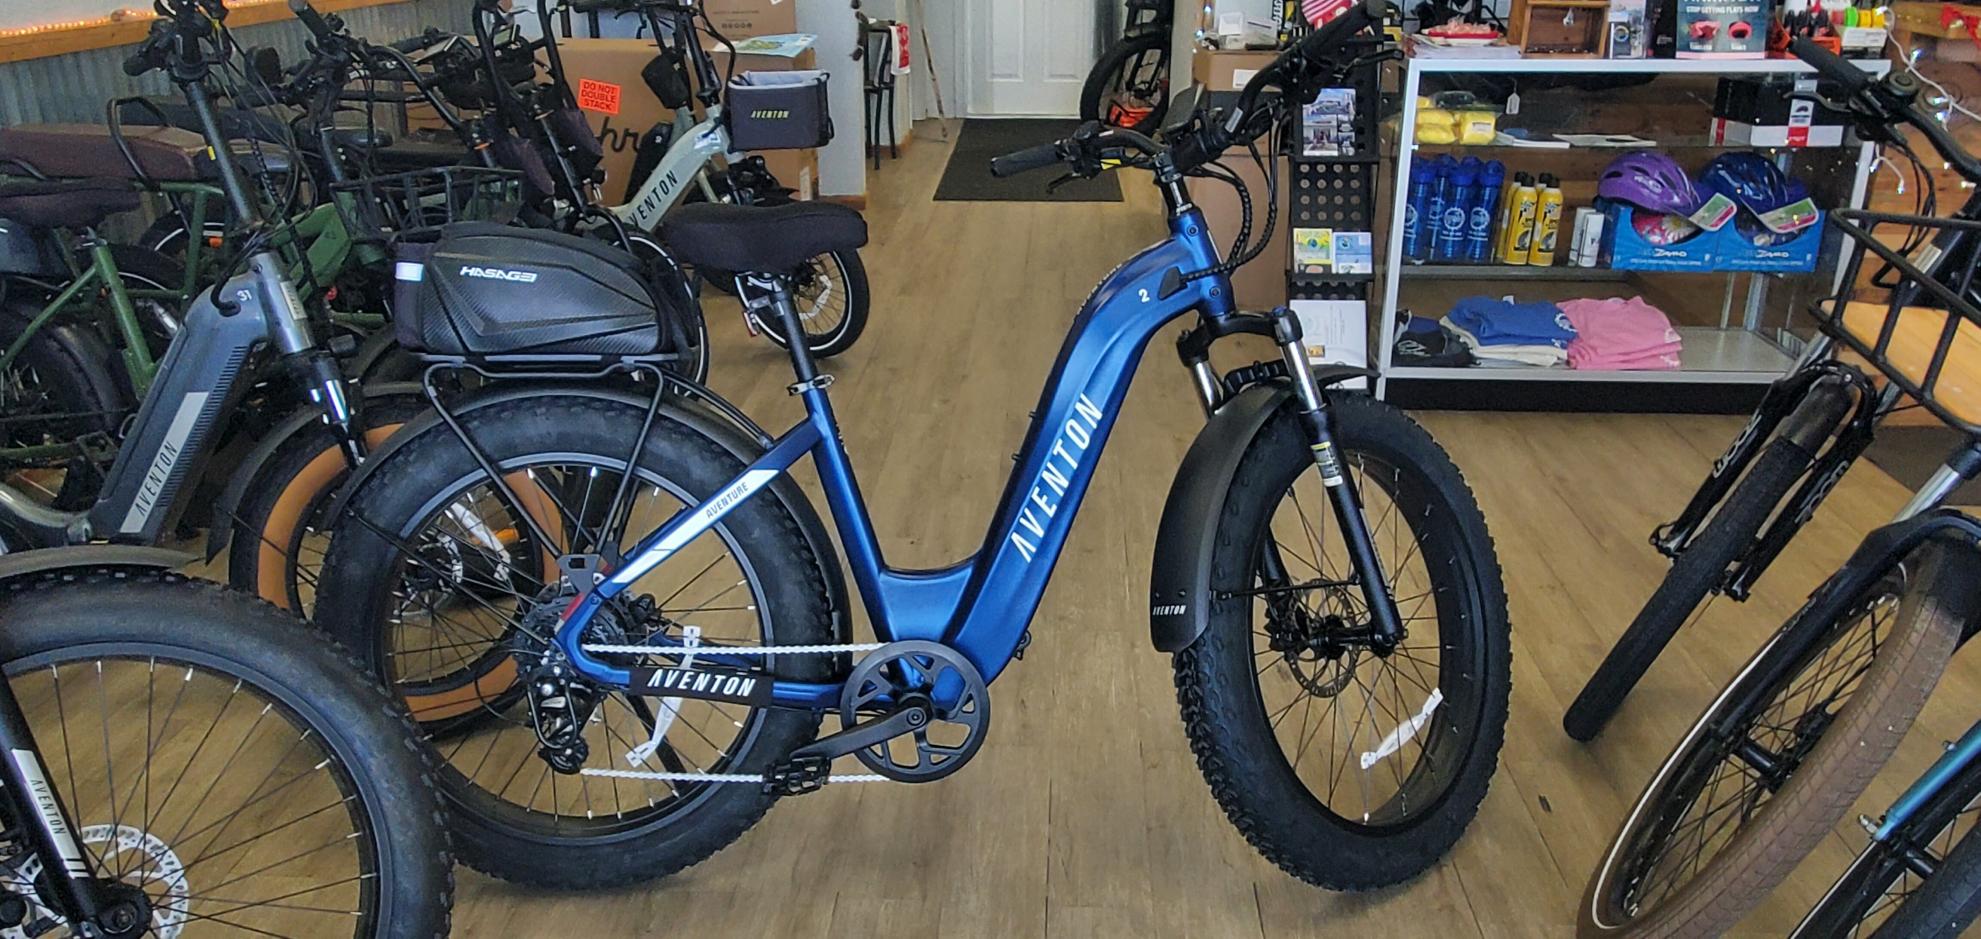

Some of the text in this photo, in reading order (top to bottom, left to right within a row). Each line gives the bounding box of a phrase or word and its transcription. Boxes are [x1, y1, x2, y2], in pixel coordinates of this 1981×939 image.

[581, 90, 616, 103] DOUBLE
[583, 81, 617, 94] DO NOT
[584, 99, 612, 111] STACK
[750, 110, 789, 118] AVENTON
[628, 170, 678, 227] VENTON
[1138, 288, 1150, 303] 2
[132, 442, 178, 516] AVENTON
[1011, 393, 1103, 563] AVENTON
[706, 482, 748, 518] AVENTURE
[1152, 605, 1187, 616] AVENTON
[647, 668, 756, 697] AVENTON
[31, 779, 67, 834] AVENTON
